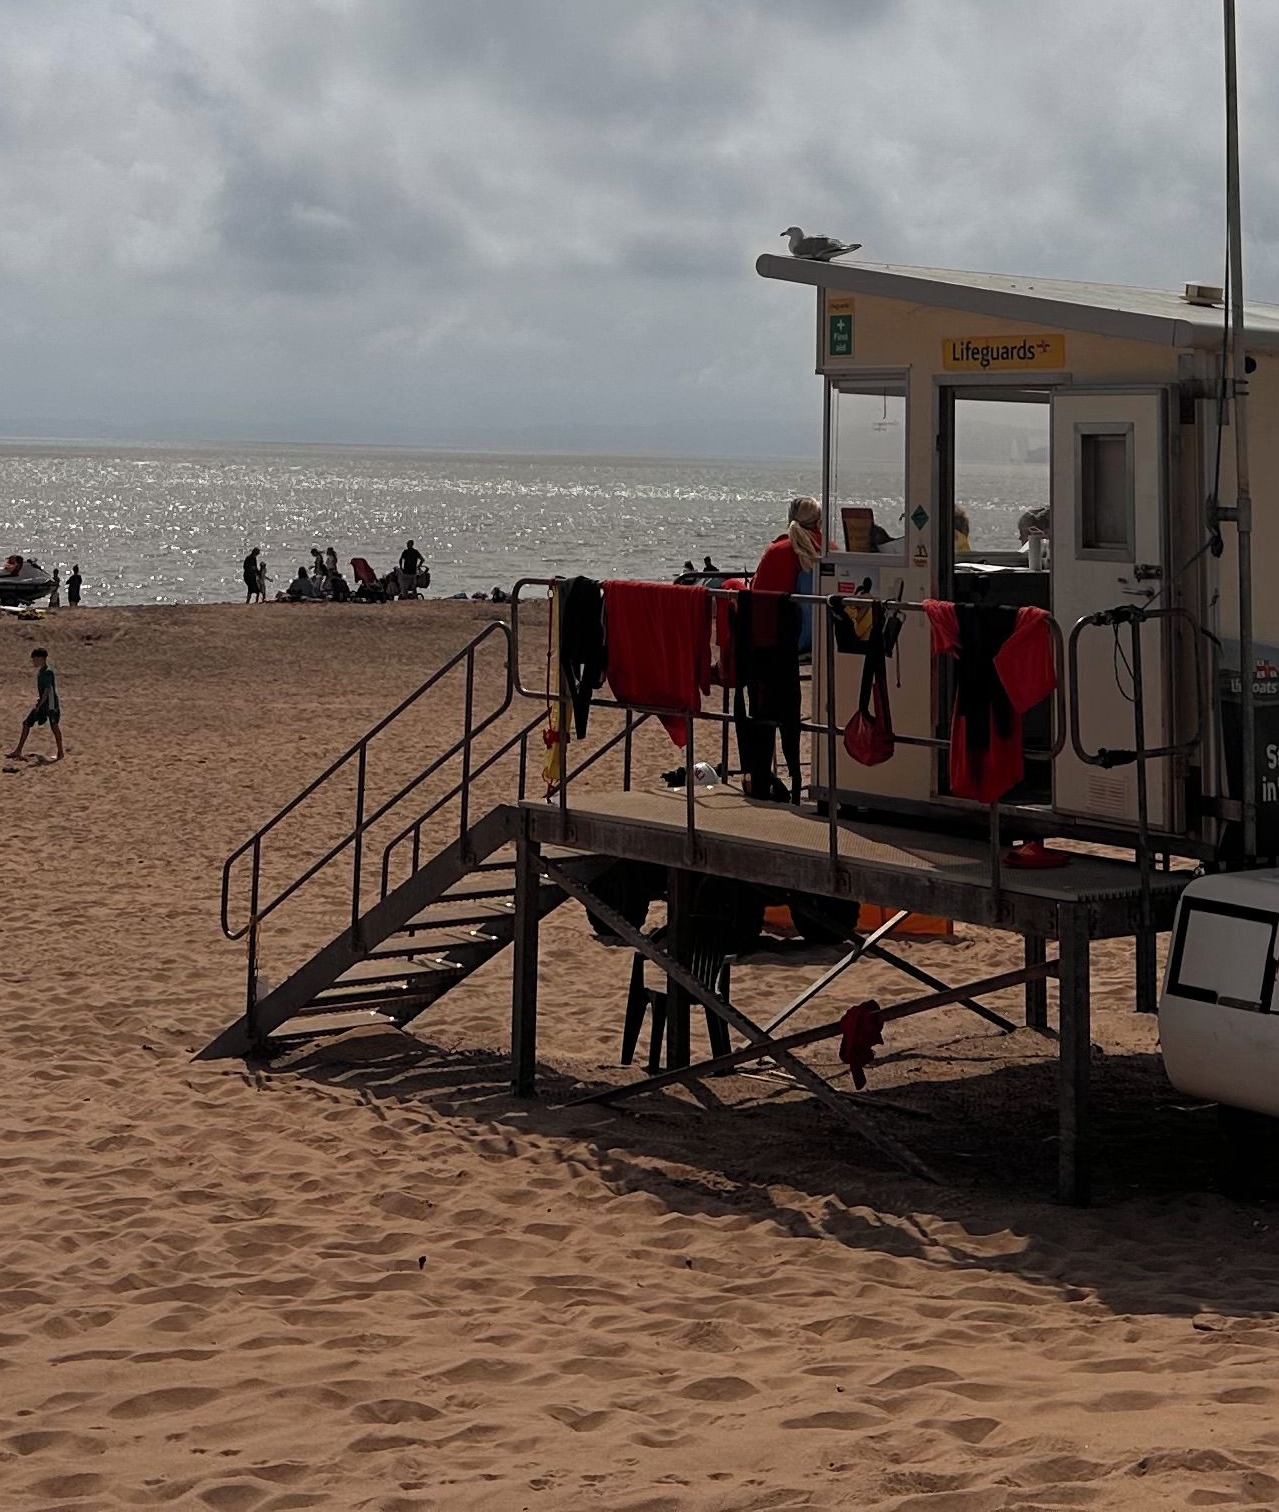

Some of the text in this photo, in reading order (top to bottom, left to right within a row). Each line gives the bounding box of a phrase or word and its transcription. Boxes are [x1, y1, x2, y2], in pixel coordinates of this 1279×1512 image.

[952, 339, 1035, 367] Lifeguards
[1231, 678, 1278, 694] Lioats
[1262, 776, 1277, 802] in
